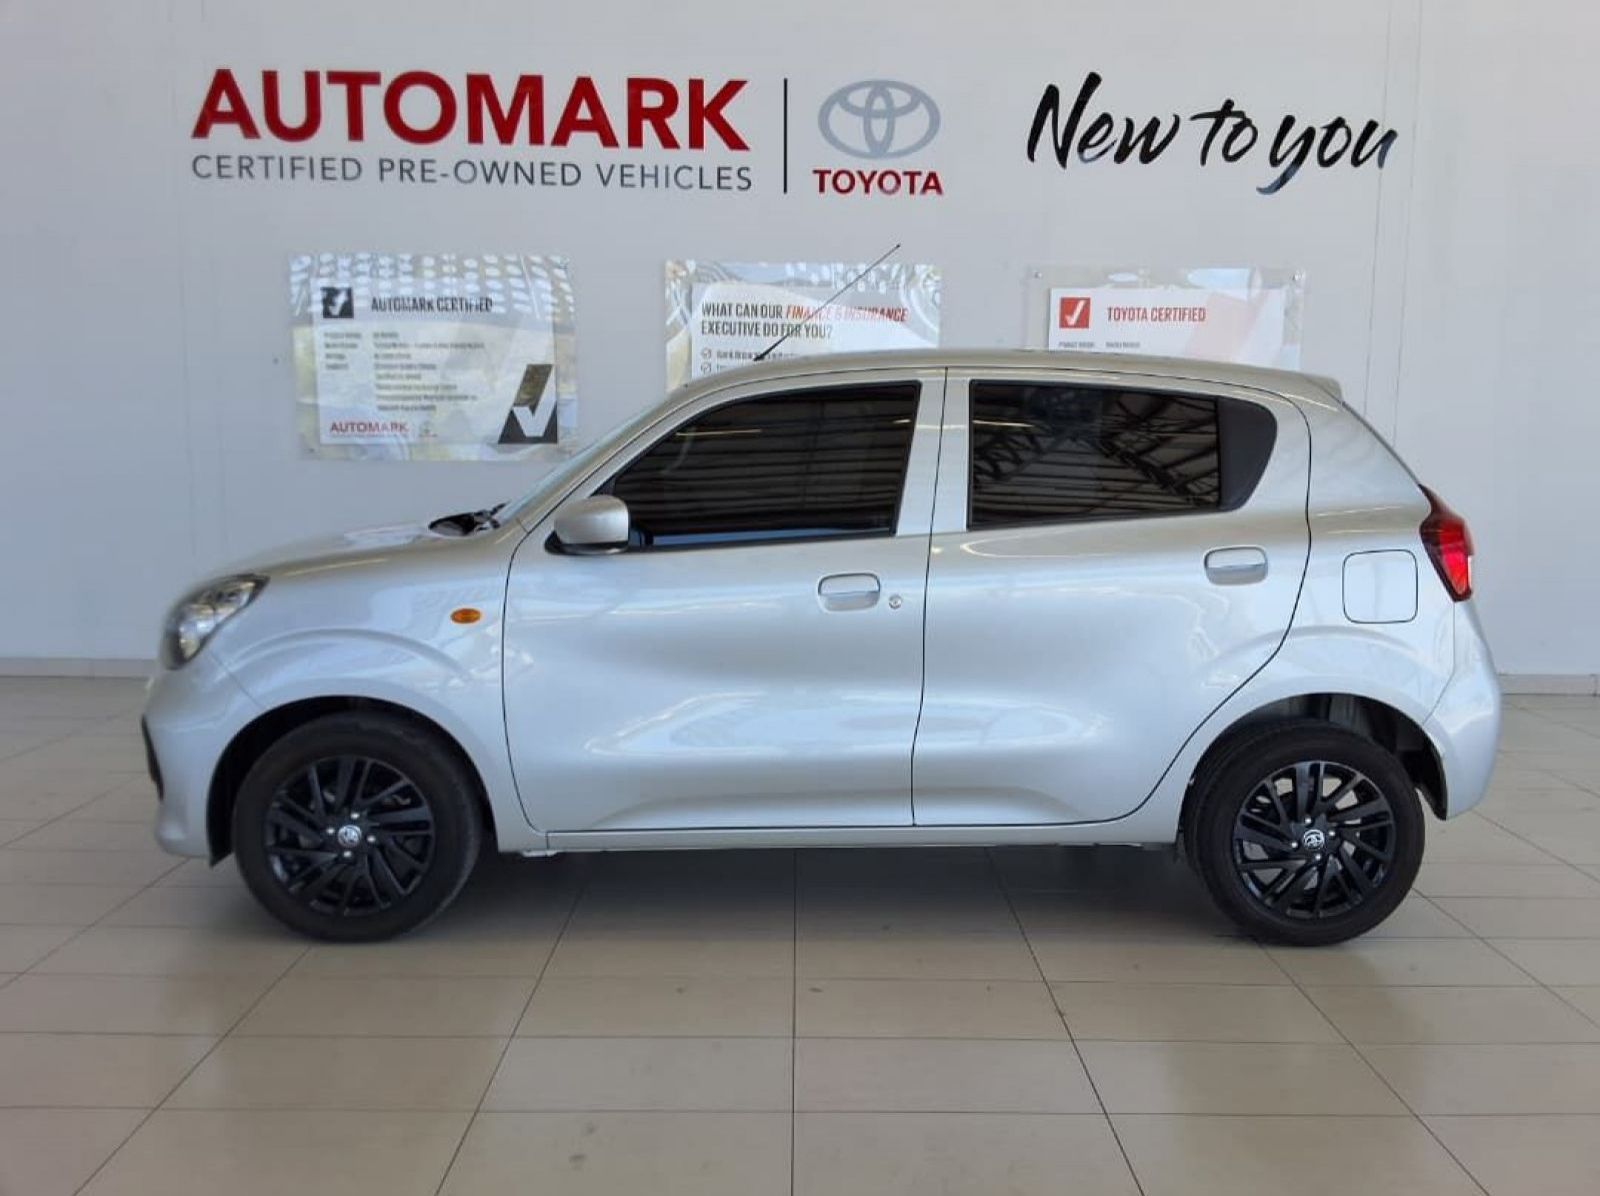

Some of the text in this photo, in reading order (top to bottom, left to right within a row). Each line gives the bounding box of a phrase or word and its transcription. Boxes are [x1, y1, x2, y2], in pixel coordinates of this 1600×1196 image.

[191, 68, 750, 152] AUTOMARK
[1026, 71, 1398, 196] New to you
[191, 153, 753, 192] CERTIFIED PRE-OWNED VEHICLES
[812, 168, 944, 197] TOYOTA
[371, 296, 434, 313] AUTOMARK
[701, 302, 734, 319] WHAT
[735, 303, 758, 319] CAN
[760, 304, 783, 320] OUR
[1107, 306, 1206, 323] TOYOTA CERTIFIED
[701, 320, 832, 339] EXECUTIVE DO FOR YOU?
[330, 421, 409, 434] AUTOMARK
